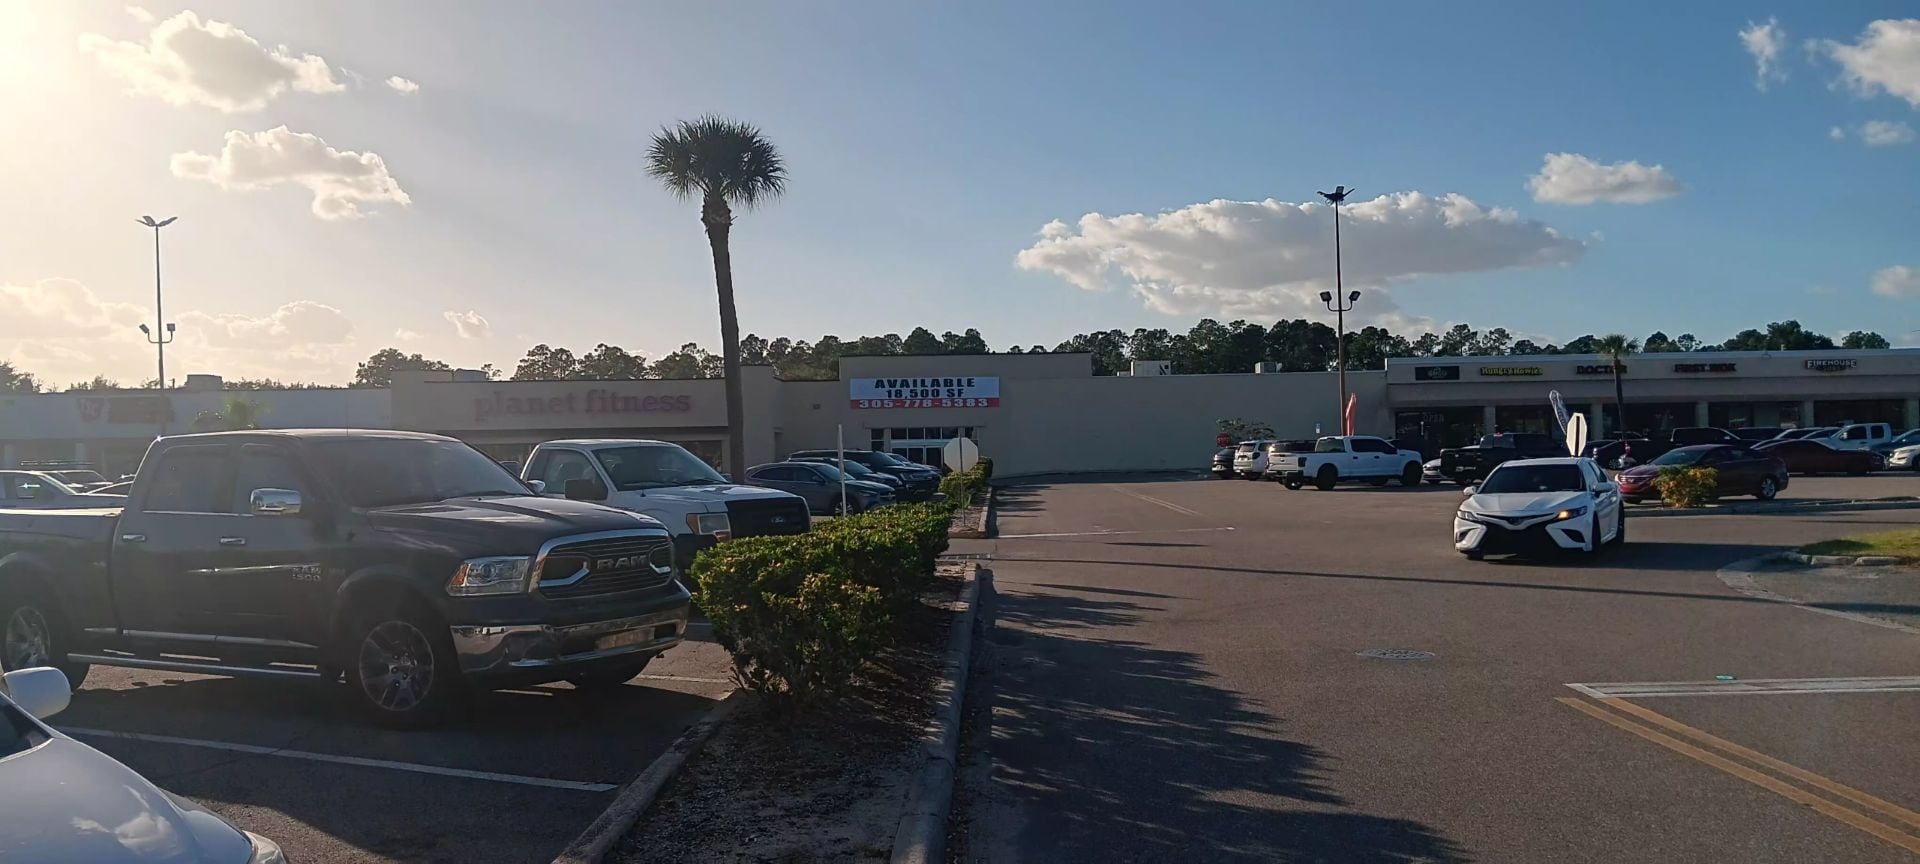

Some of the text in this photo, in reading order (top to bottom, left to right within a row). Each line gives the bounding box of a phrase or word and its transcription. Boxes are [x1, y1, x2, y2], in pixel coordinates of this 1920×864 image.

[1807, 359, 1857, 369] FIREHOUSE
[874, 378, 976, 389] AVAILABLE
[886, 388, 965, 399] 18,500 SF
[474, 389, 693, 422] planet fitness
[859, 398, 988, 408] 305-778-5383
[596, 555, 648, 570] RAM
